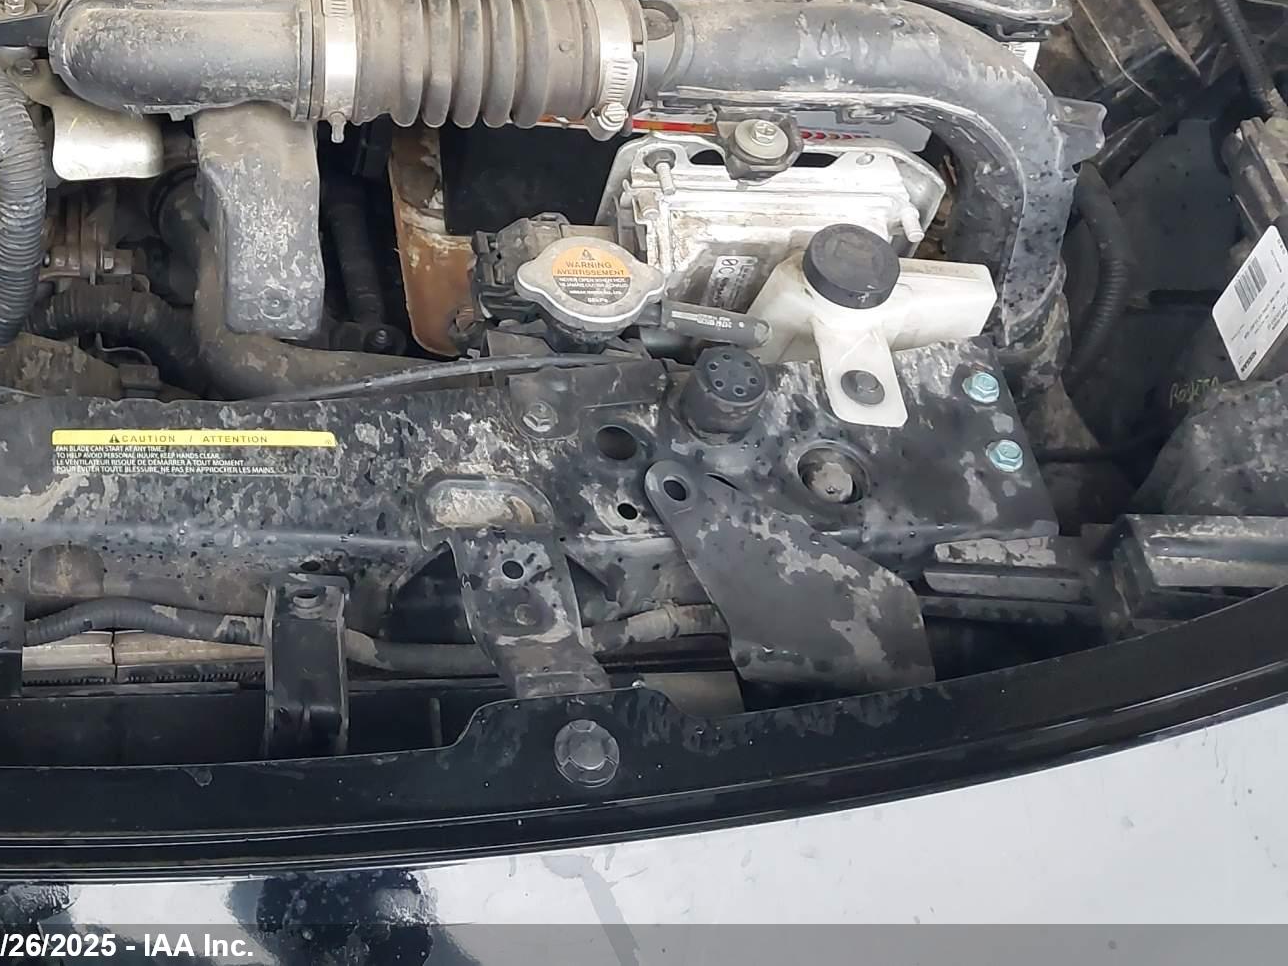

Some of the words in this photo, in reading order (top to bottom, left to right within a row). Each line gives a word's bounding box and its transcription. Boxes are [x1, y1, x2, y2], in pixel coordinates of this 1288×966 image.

[566, 261, 612, 269] WARNING
[121, 435, 176, 443] CAUTION
[203, 435, 268, 443] ATTENTION
